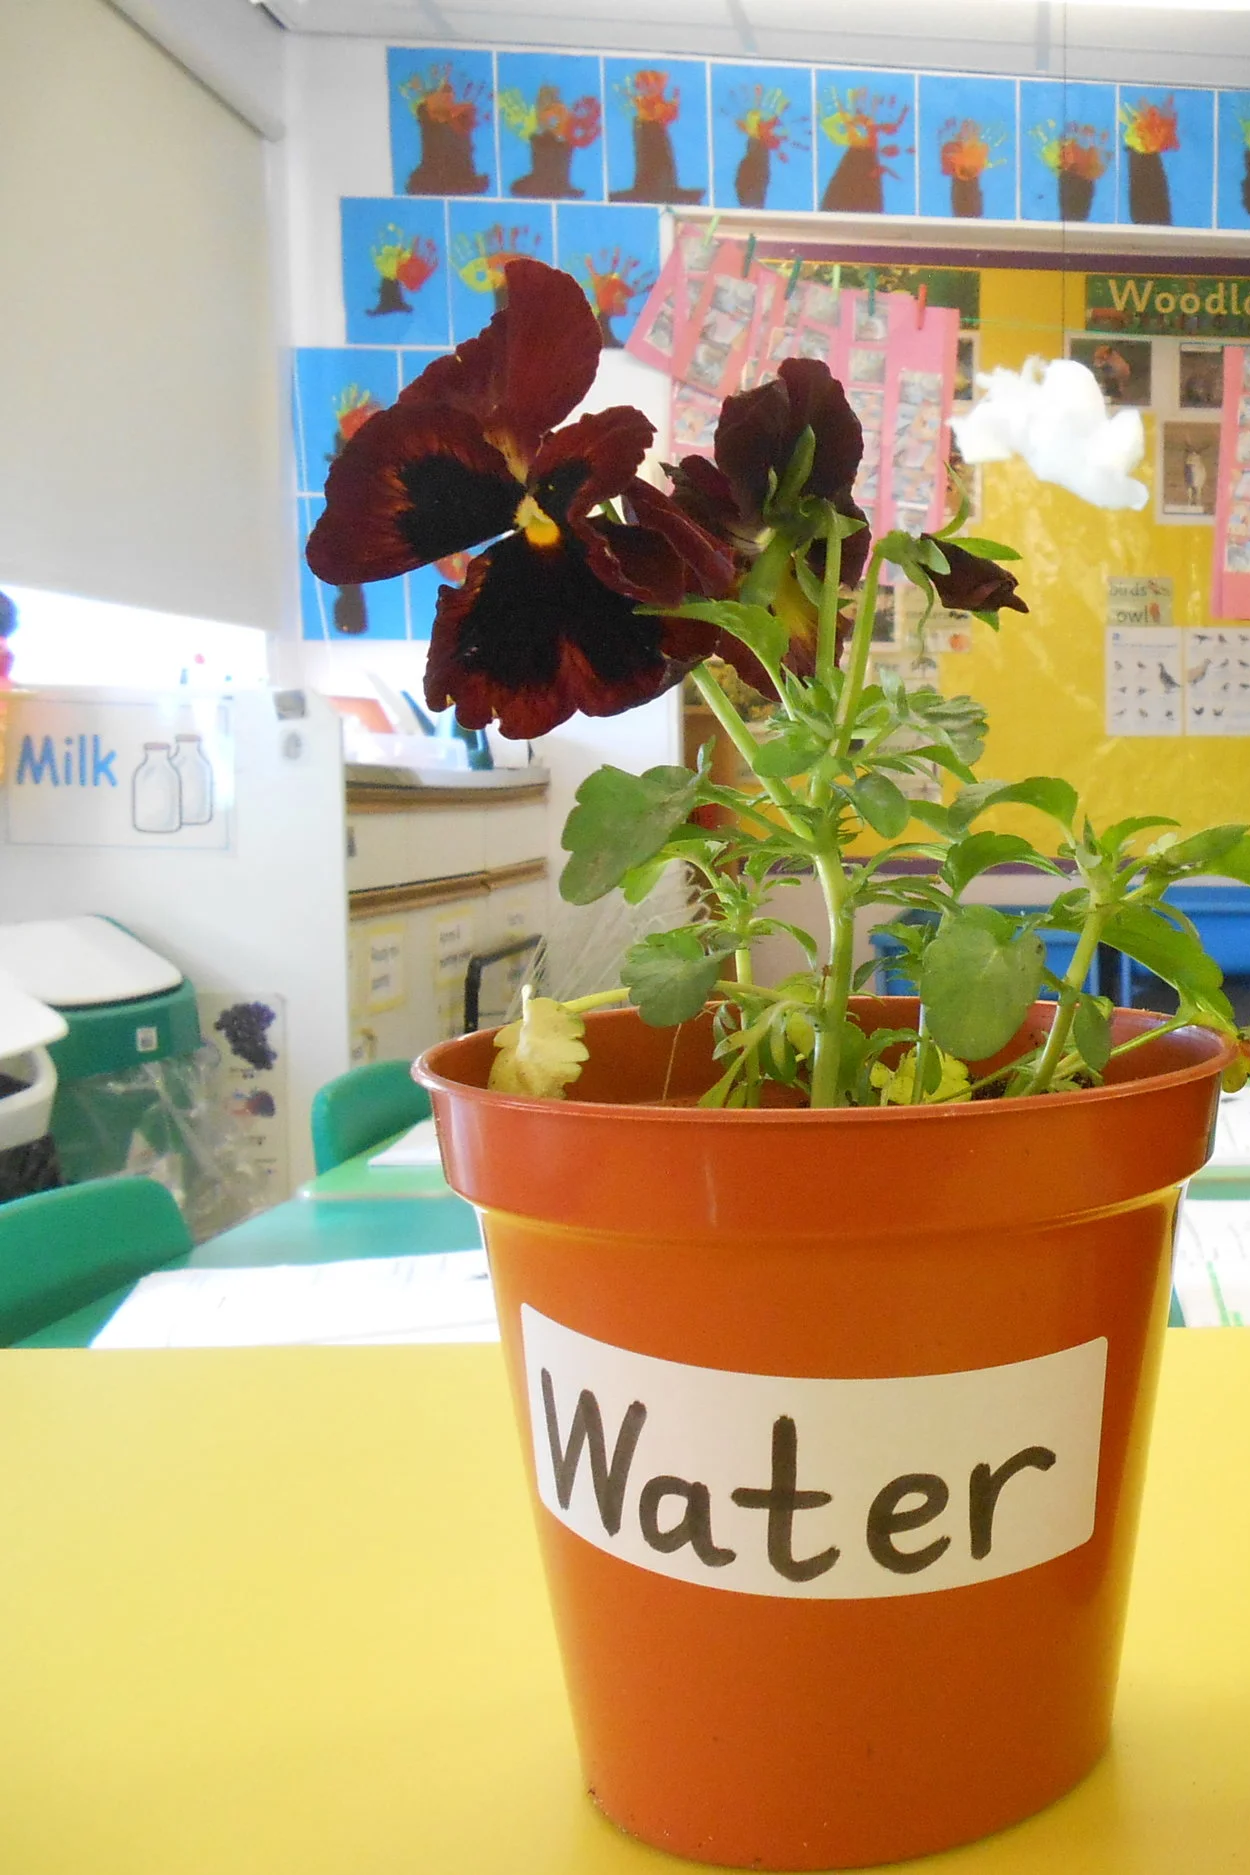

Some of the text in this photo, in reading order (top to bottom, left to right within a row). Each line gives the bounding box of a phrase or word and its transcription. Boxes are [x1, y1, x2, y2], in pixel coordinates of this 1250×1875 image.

[1109, 582, 1148, 597] birds
[1116, 604, 1149, 623] owl
[16, 734, 118, 787] Milk
[541, 1367, 1056, 1582] Water
